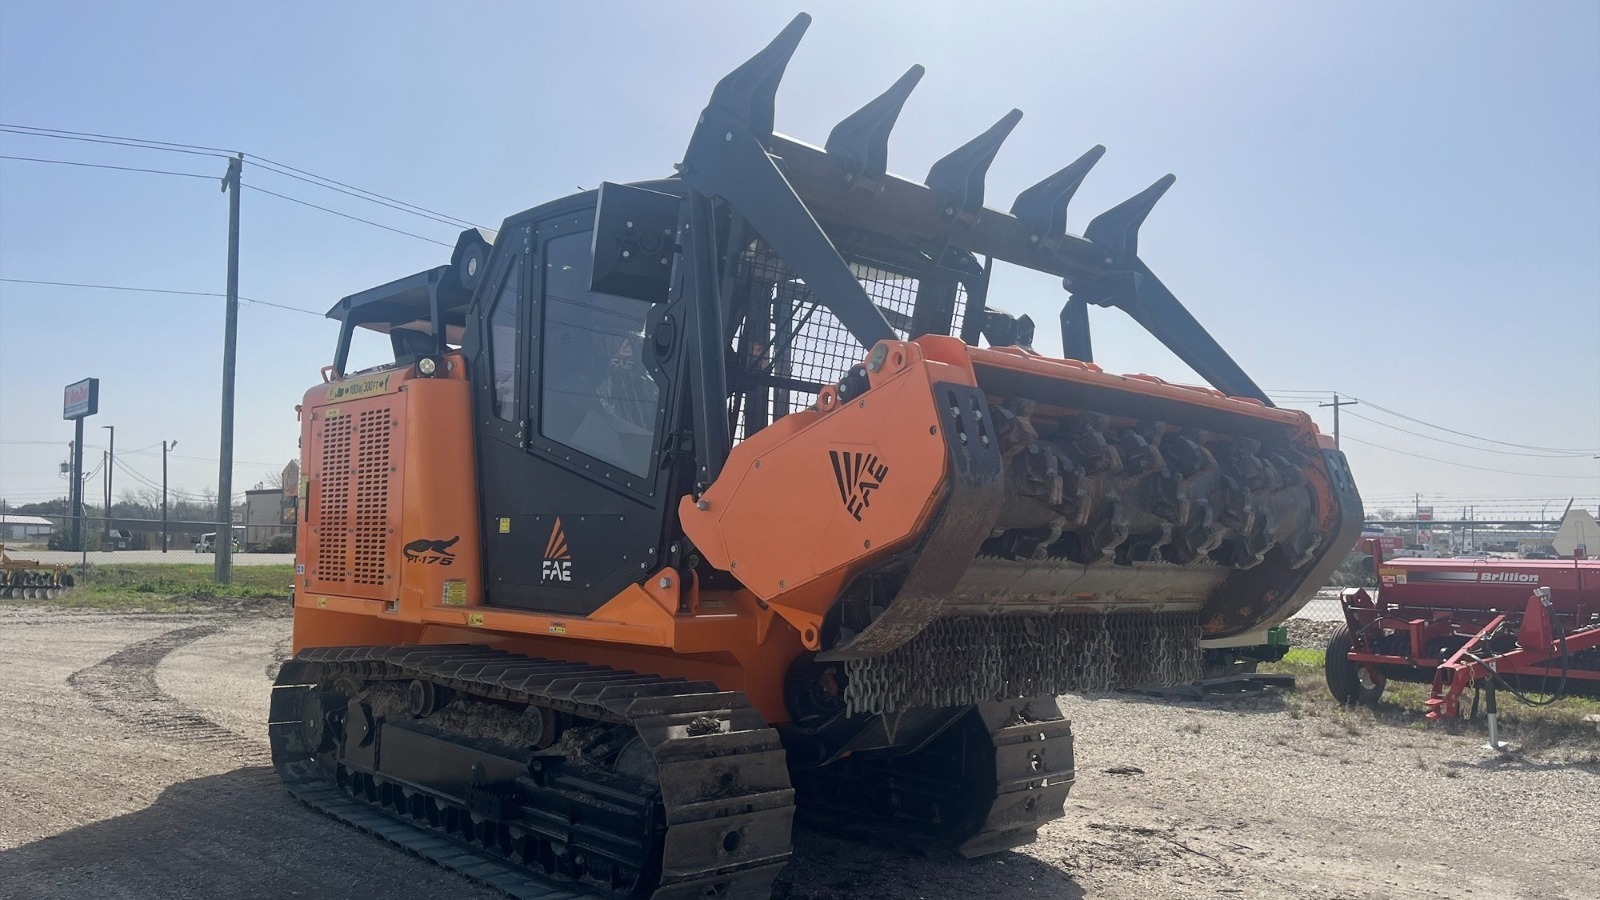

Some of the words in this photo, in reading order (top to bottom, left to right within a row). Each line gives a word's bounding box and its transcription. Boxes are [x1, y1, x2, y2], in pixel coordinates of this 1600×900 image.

[847, 455, 889, 522] FAE
[407, 555, 455, 566] PT-175
[542, 560, 572, 581] FAE
[1481, 571, 1539, 582] Brillion
